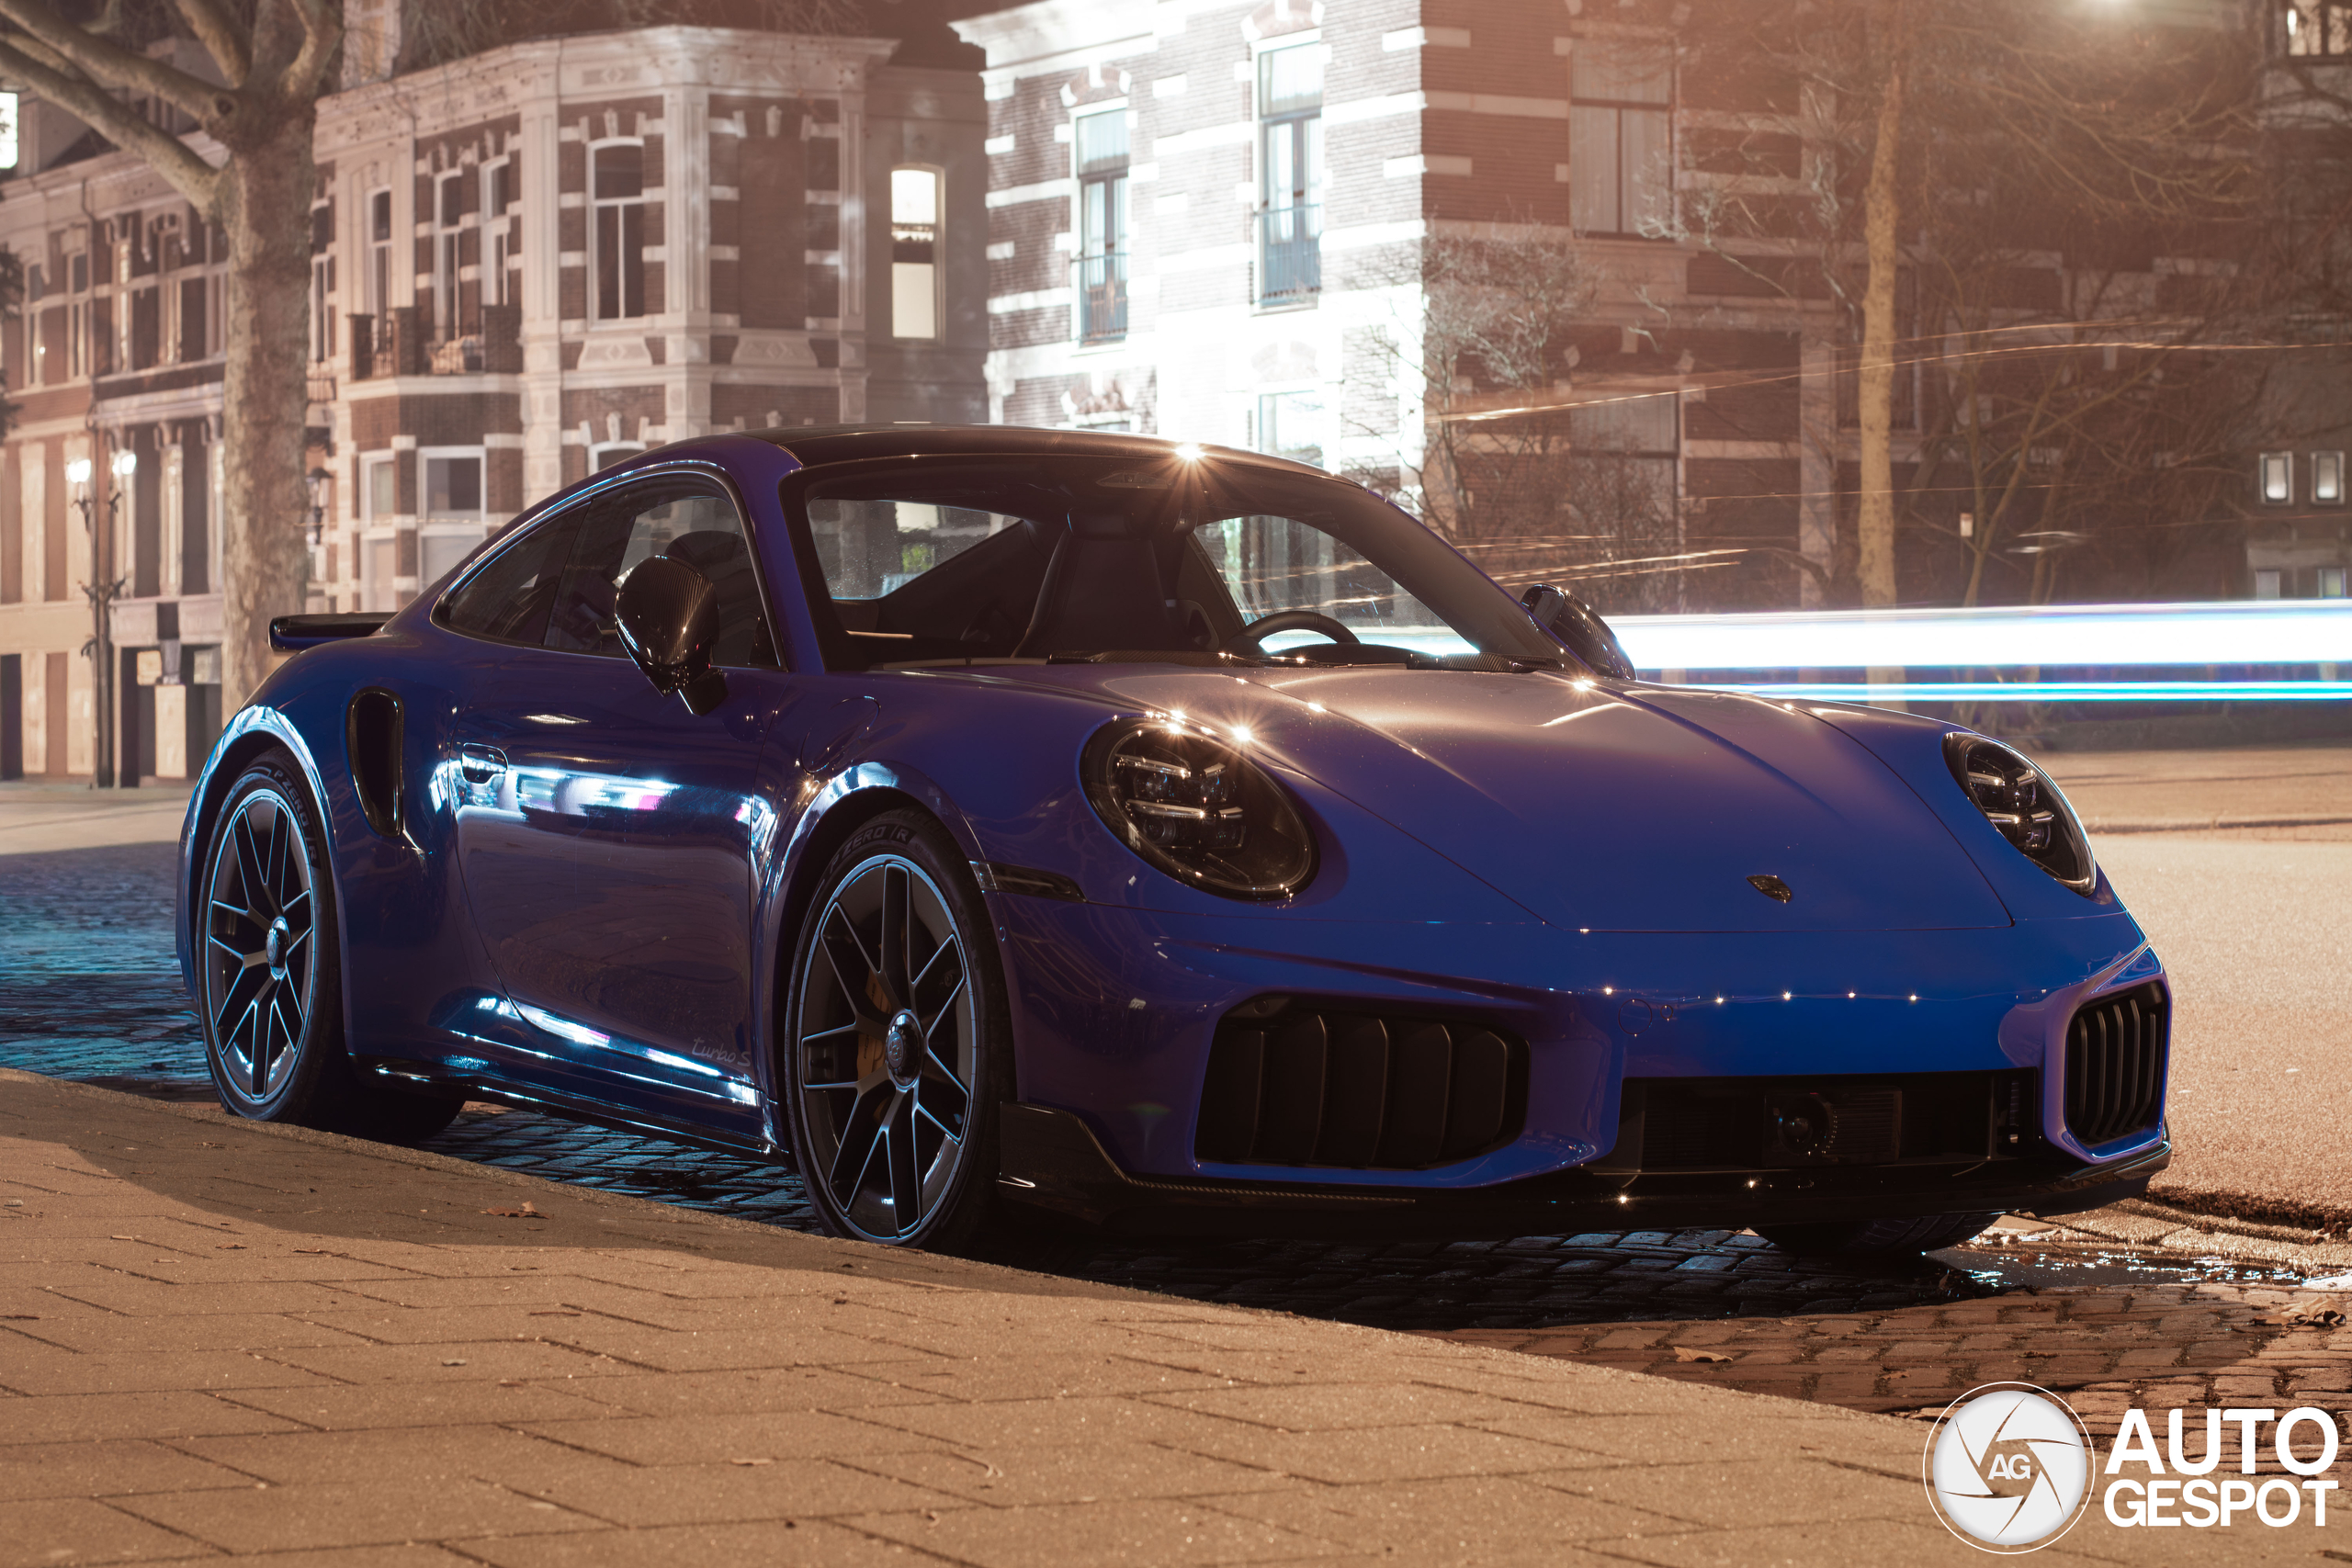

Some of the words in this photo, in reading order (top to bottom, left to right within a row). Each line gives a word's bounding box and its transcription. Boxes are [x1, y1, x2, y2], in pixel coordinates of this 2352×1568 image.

[274, 770, 284, 778] P
[282, 778, 310, 827] ZERO
[829, 854, 840, 874] P
[842, 826, 887, 859] ZERO
[737, 1051, 751, 1066] S
